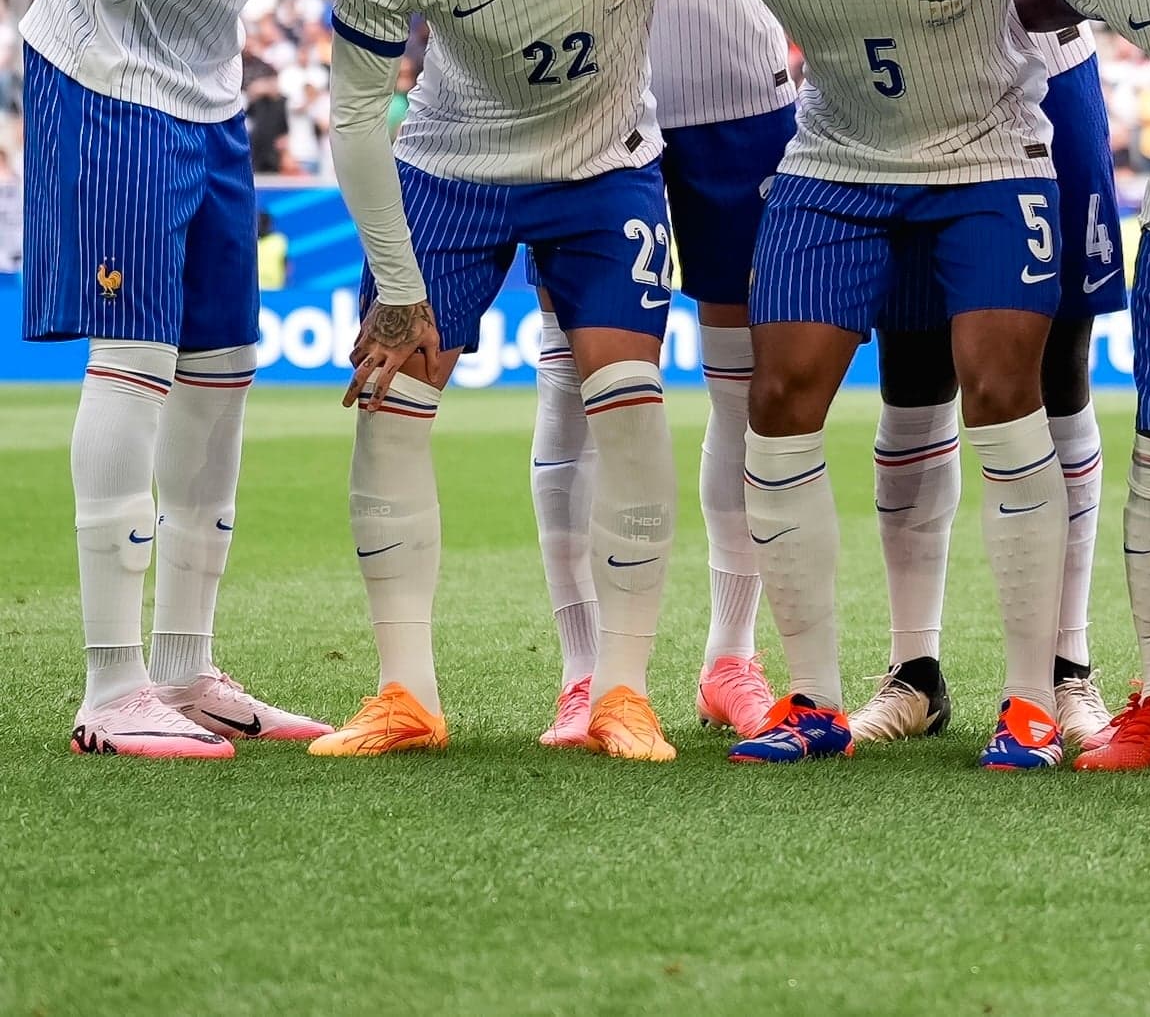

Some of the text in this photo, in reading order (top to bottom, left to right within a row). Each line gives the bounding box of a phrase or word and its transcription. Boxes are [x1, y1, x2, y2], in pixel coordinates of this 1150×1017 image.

[522, 31, 599, 85] 22
[864, 37, 906, 99] 5
[623, 218, 672, 293] 22
[1018, 194, 1054, 263] 5
[1085, 193, 1114, 264] 4
[622, 515, 662, 526] THEO
